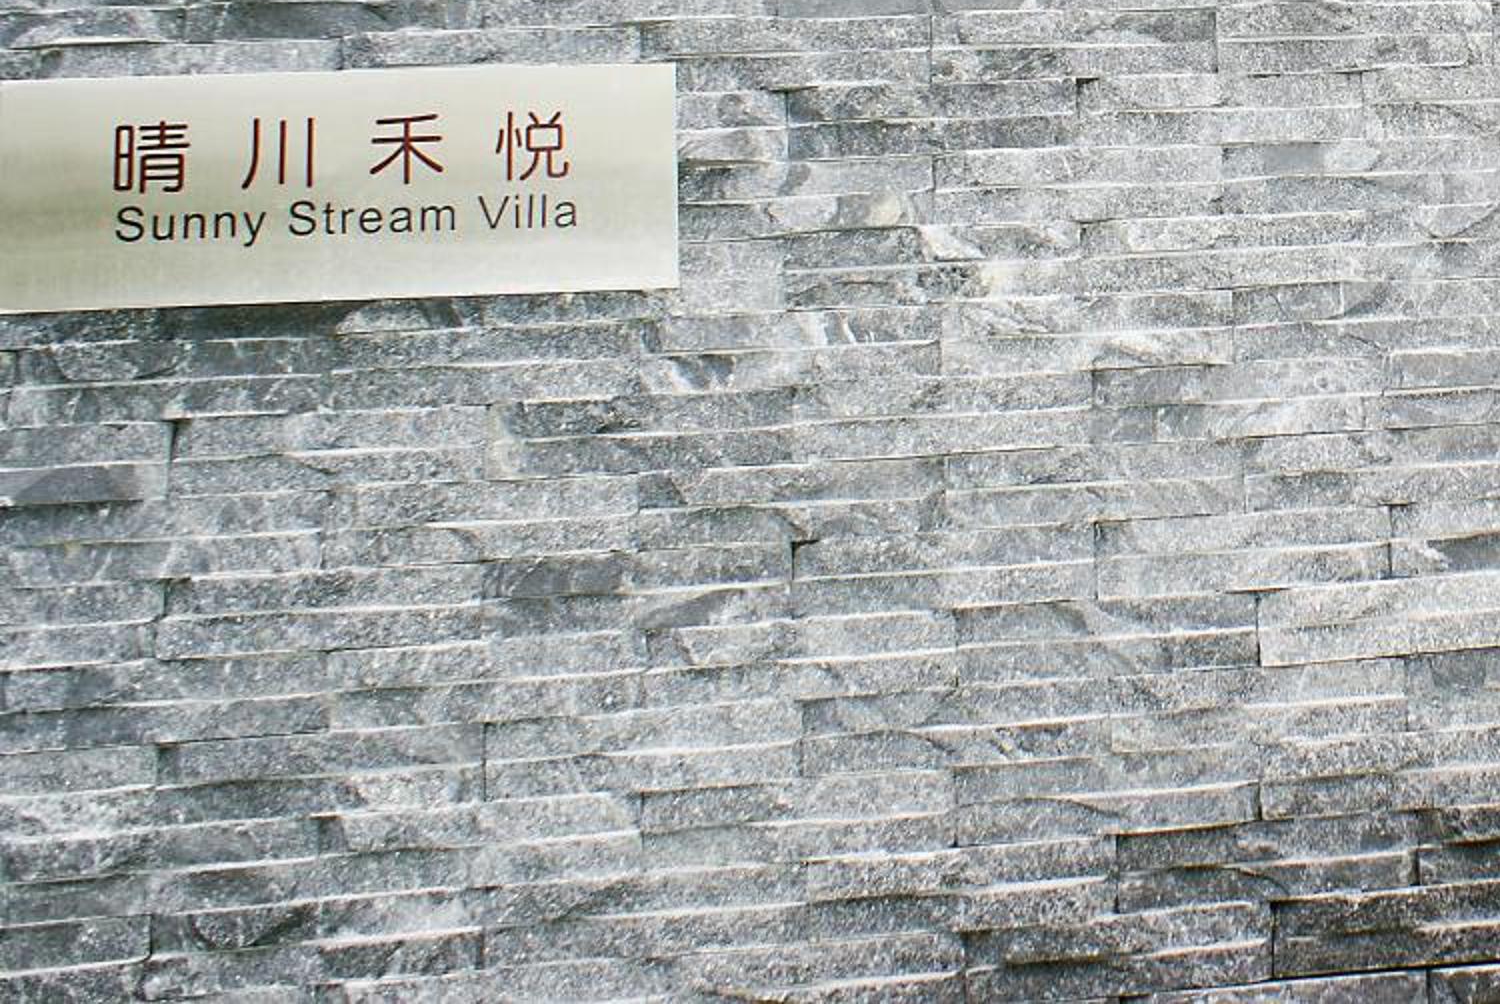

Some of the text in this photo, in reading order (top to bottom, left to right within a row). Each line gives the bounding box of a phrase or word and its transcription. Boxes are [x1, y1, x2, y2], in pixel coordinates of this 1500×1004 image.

[112, 110, 570, 196] 晴川禾悦
[114, 193, 578, 248] Sunny Stream Villa
